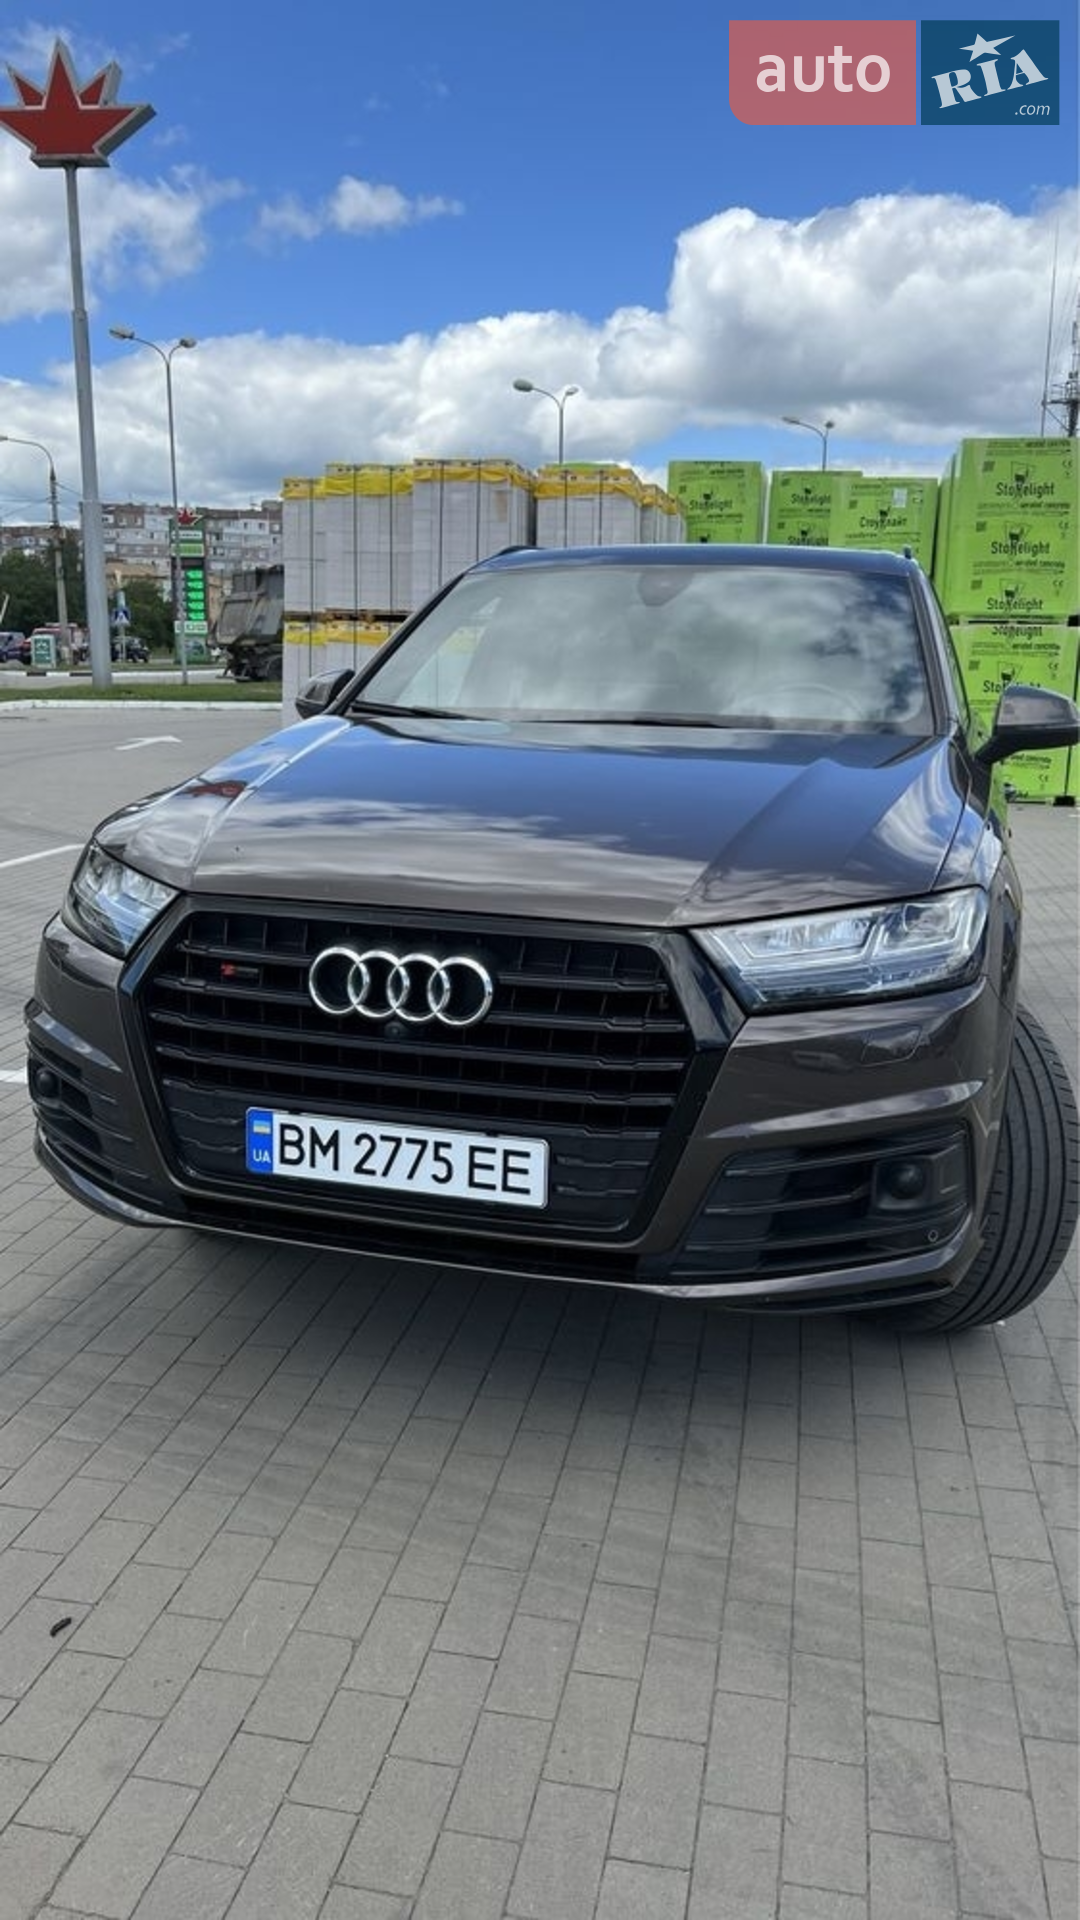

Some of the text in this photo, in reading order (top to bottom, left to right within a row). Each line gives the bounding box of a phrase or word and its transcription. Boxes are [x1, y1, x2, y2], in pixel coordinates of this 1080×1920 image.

[253, 1150, 271, 1163] UA
[279, 1122, 531, 1195] BM 2775 EE
